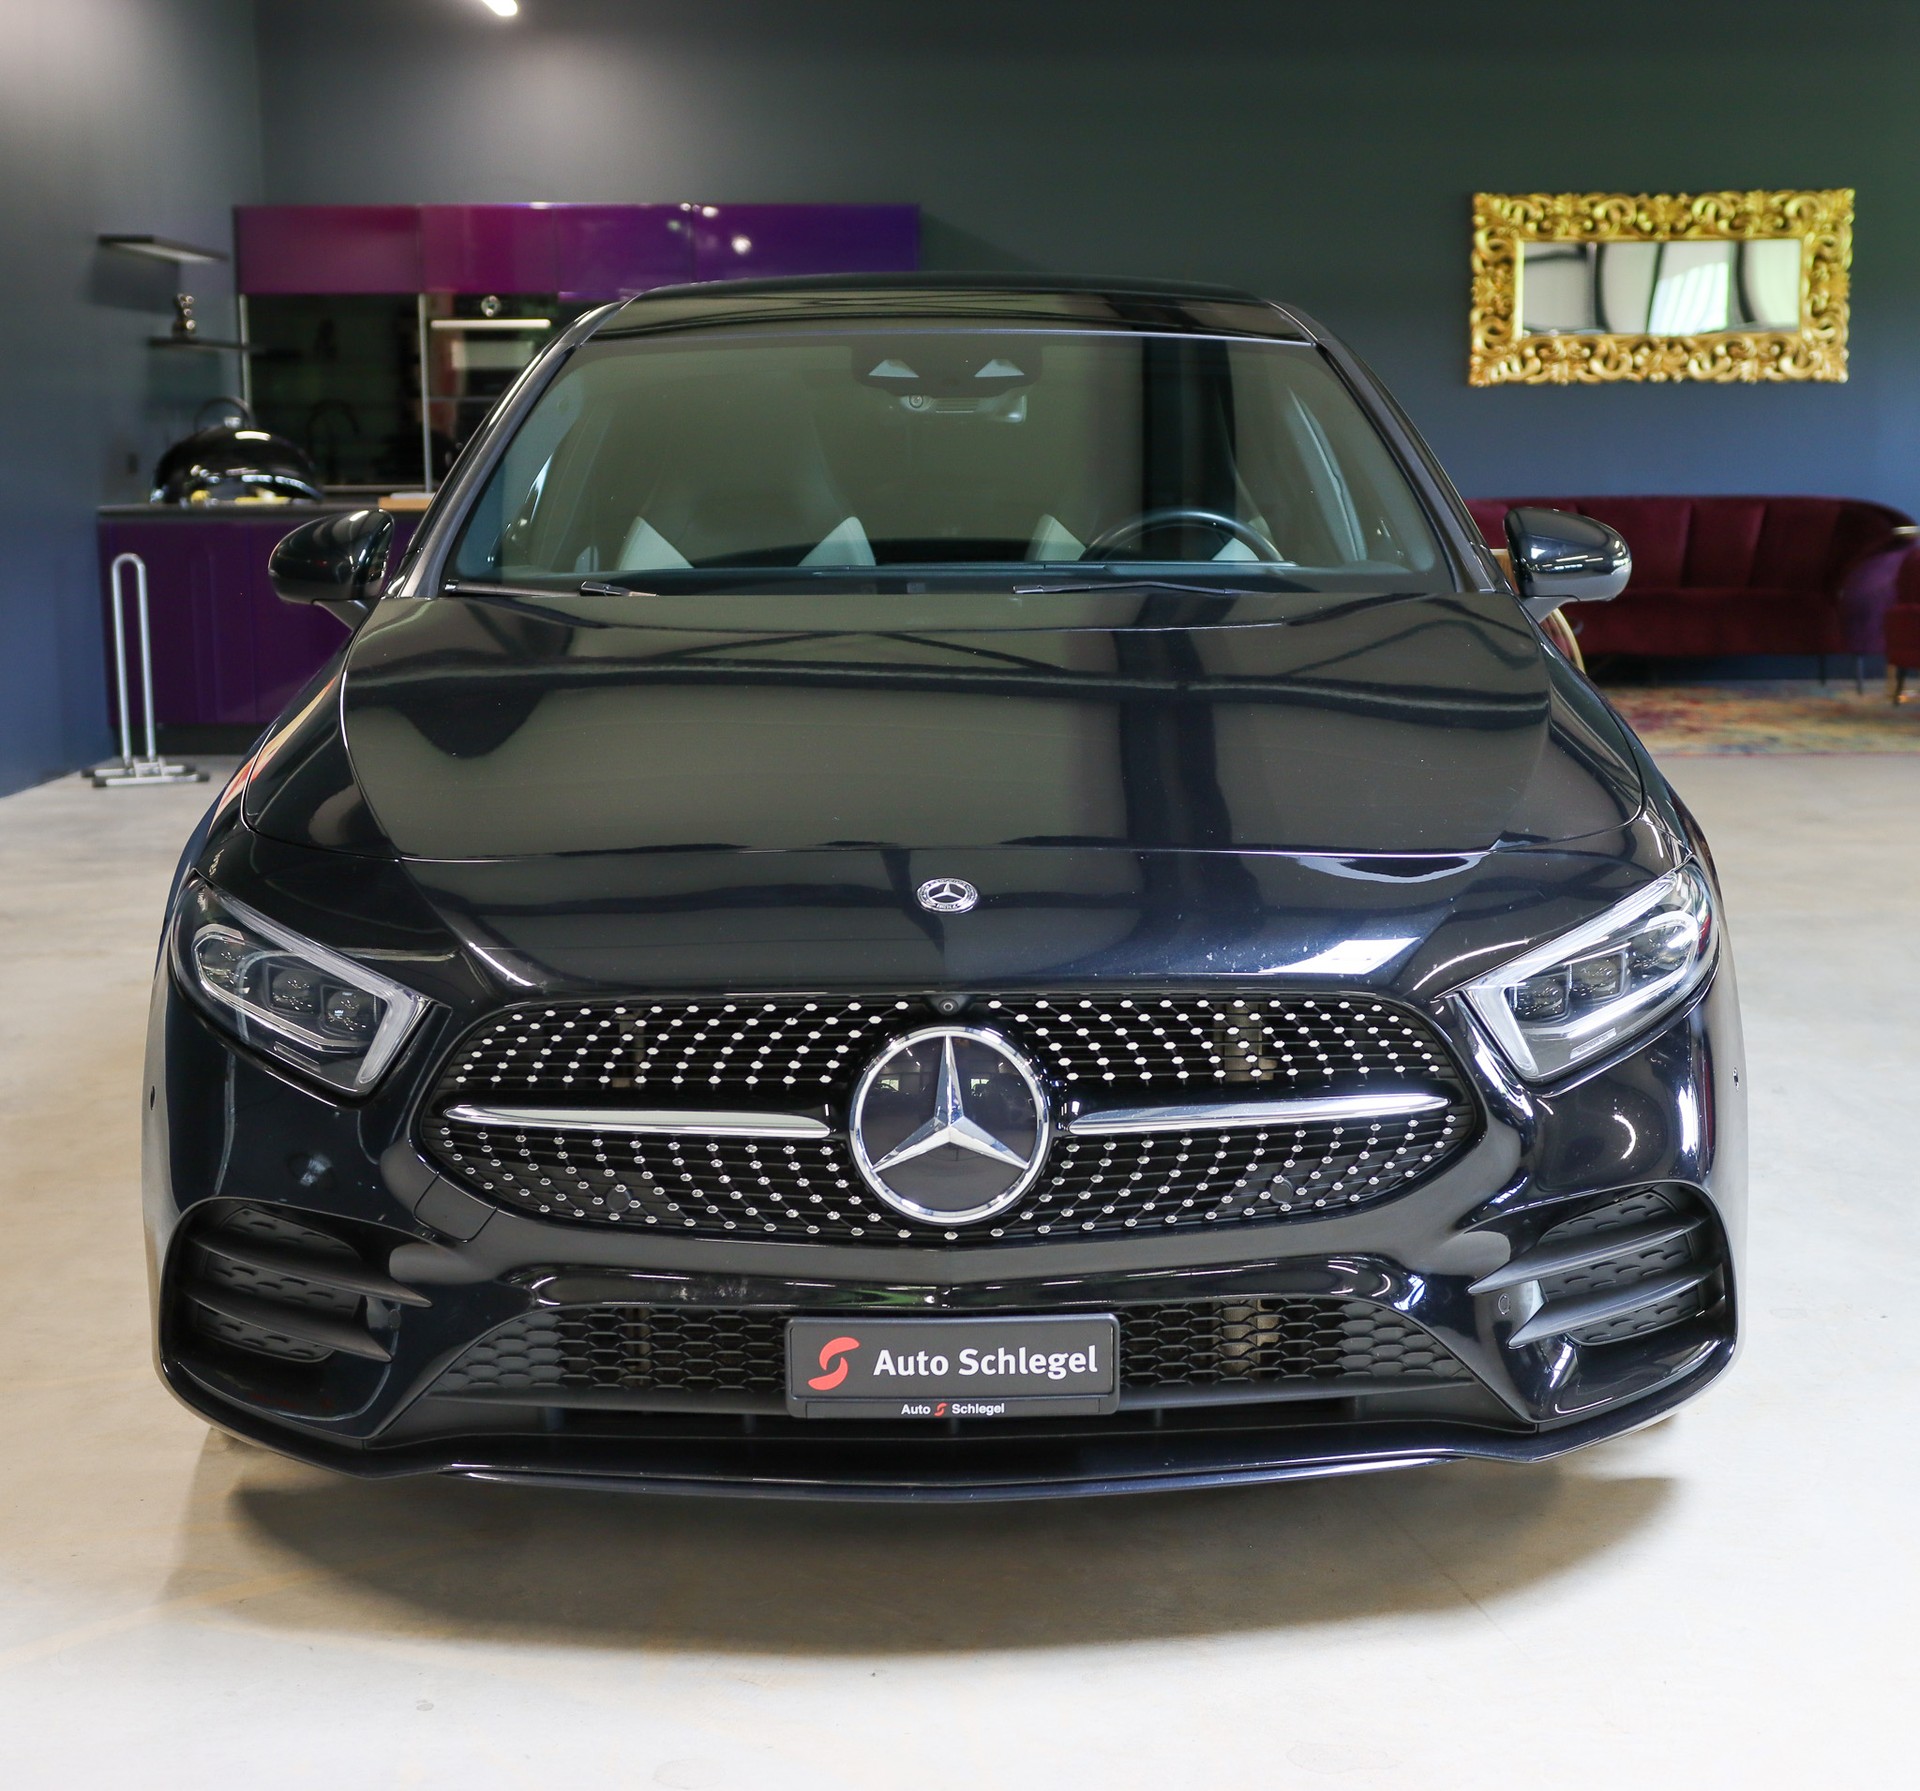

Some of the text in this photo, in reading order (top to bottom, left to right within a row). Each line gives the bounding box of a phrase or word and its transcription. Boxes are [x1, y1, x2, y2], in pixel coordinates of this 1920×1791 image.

[873, 1345, 1098, 1380] Auto Schlegel
[901, 1402, 1005, 1416] Auto Schlegel
